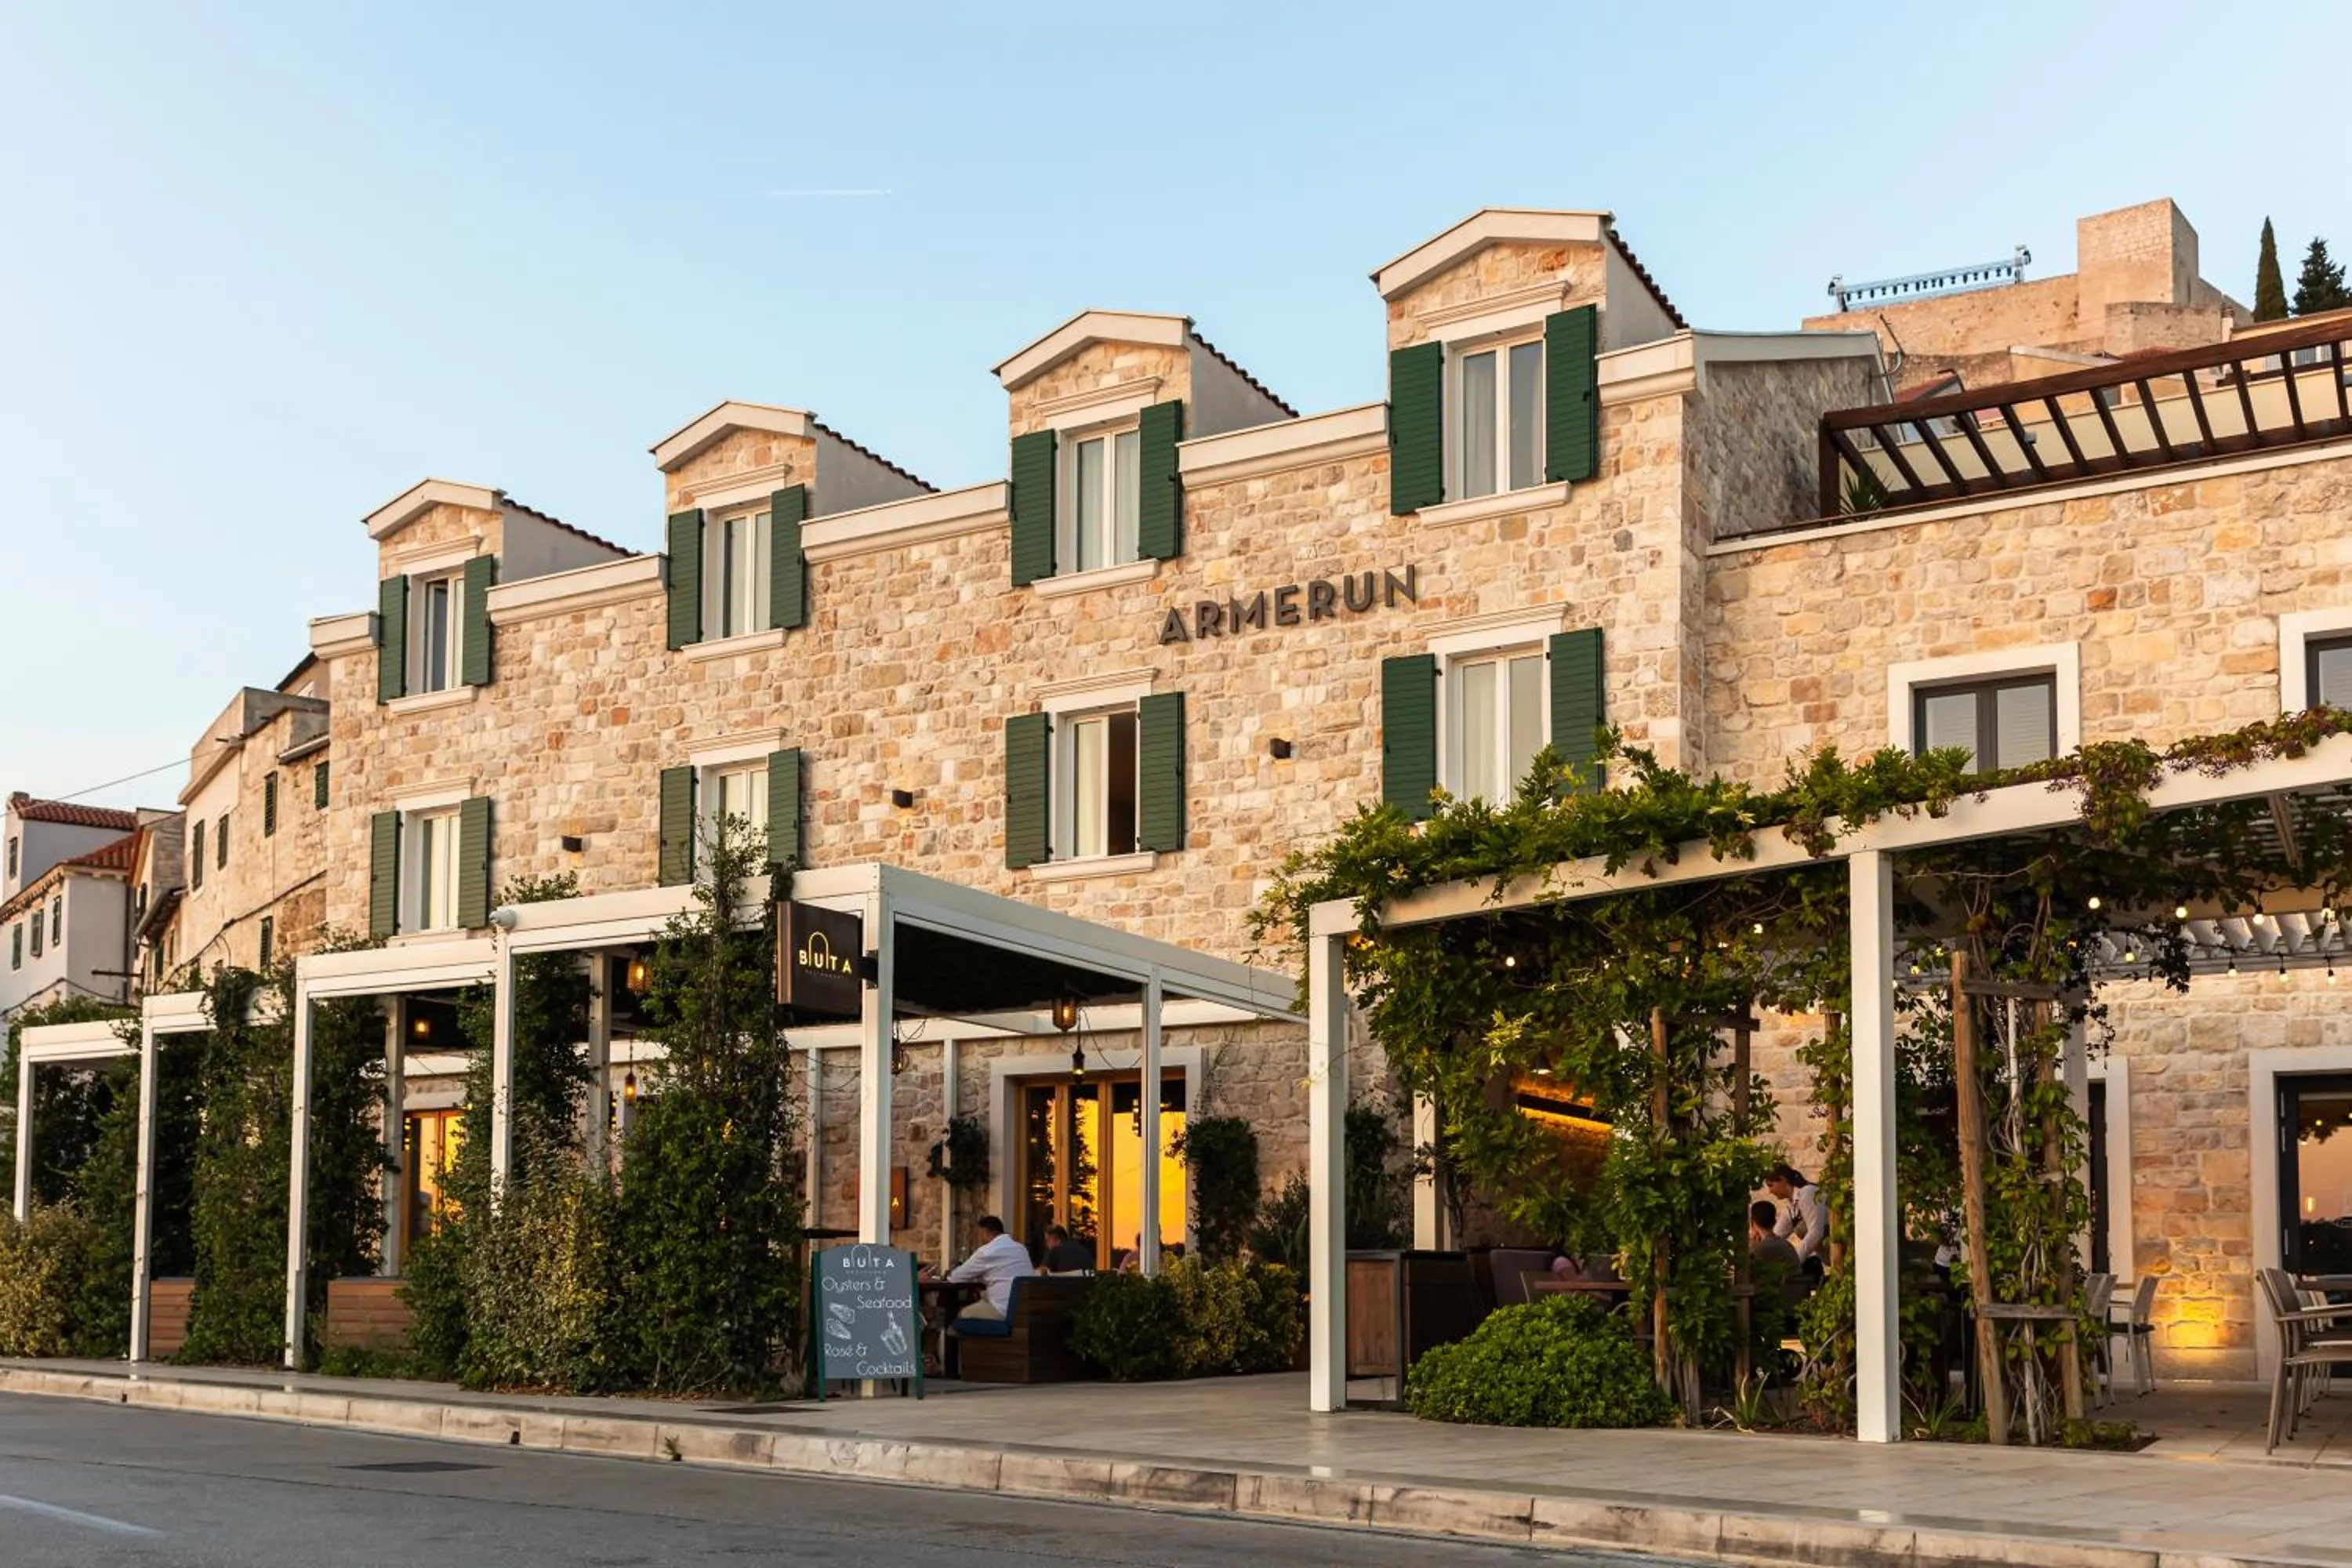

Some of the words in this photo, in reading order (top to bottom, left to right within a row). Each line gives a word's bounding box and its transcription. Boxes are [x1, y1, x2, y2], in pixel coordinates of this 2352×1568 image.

[1158, 564, 1416, 644] ARMERUN
[799, 949, 852, 974] BUTA
[843, 1257, 895, 1268] BUTA
[822, 1276, 871, 1293] Oysters
[874, 1276, 886, 1291] &
[857, 1294, 913, 1308] Seafood
[855, 1341, 868, 1356] &
[856, 1359, 916, 1375] Cocktails
